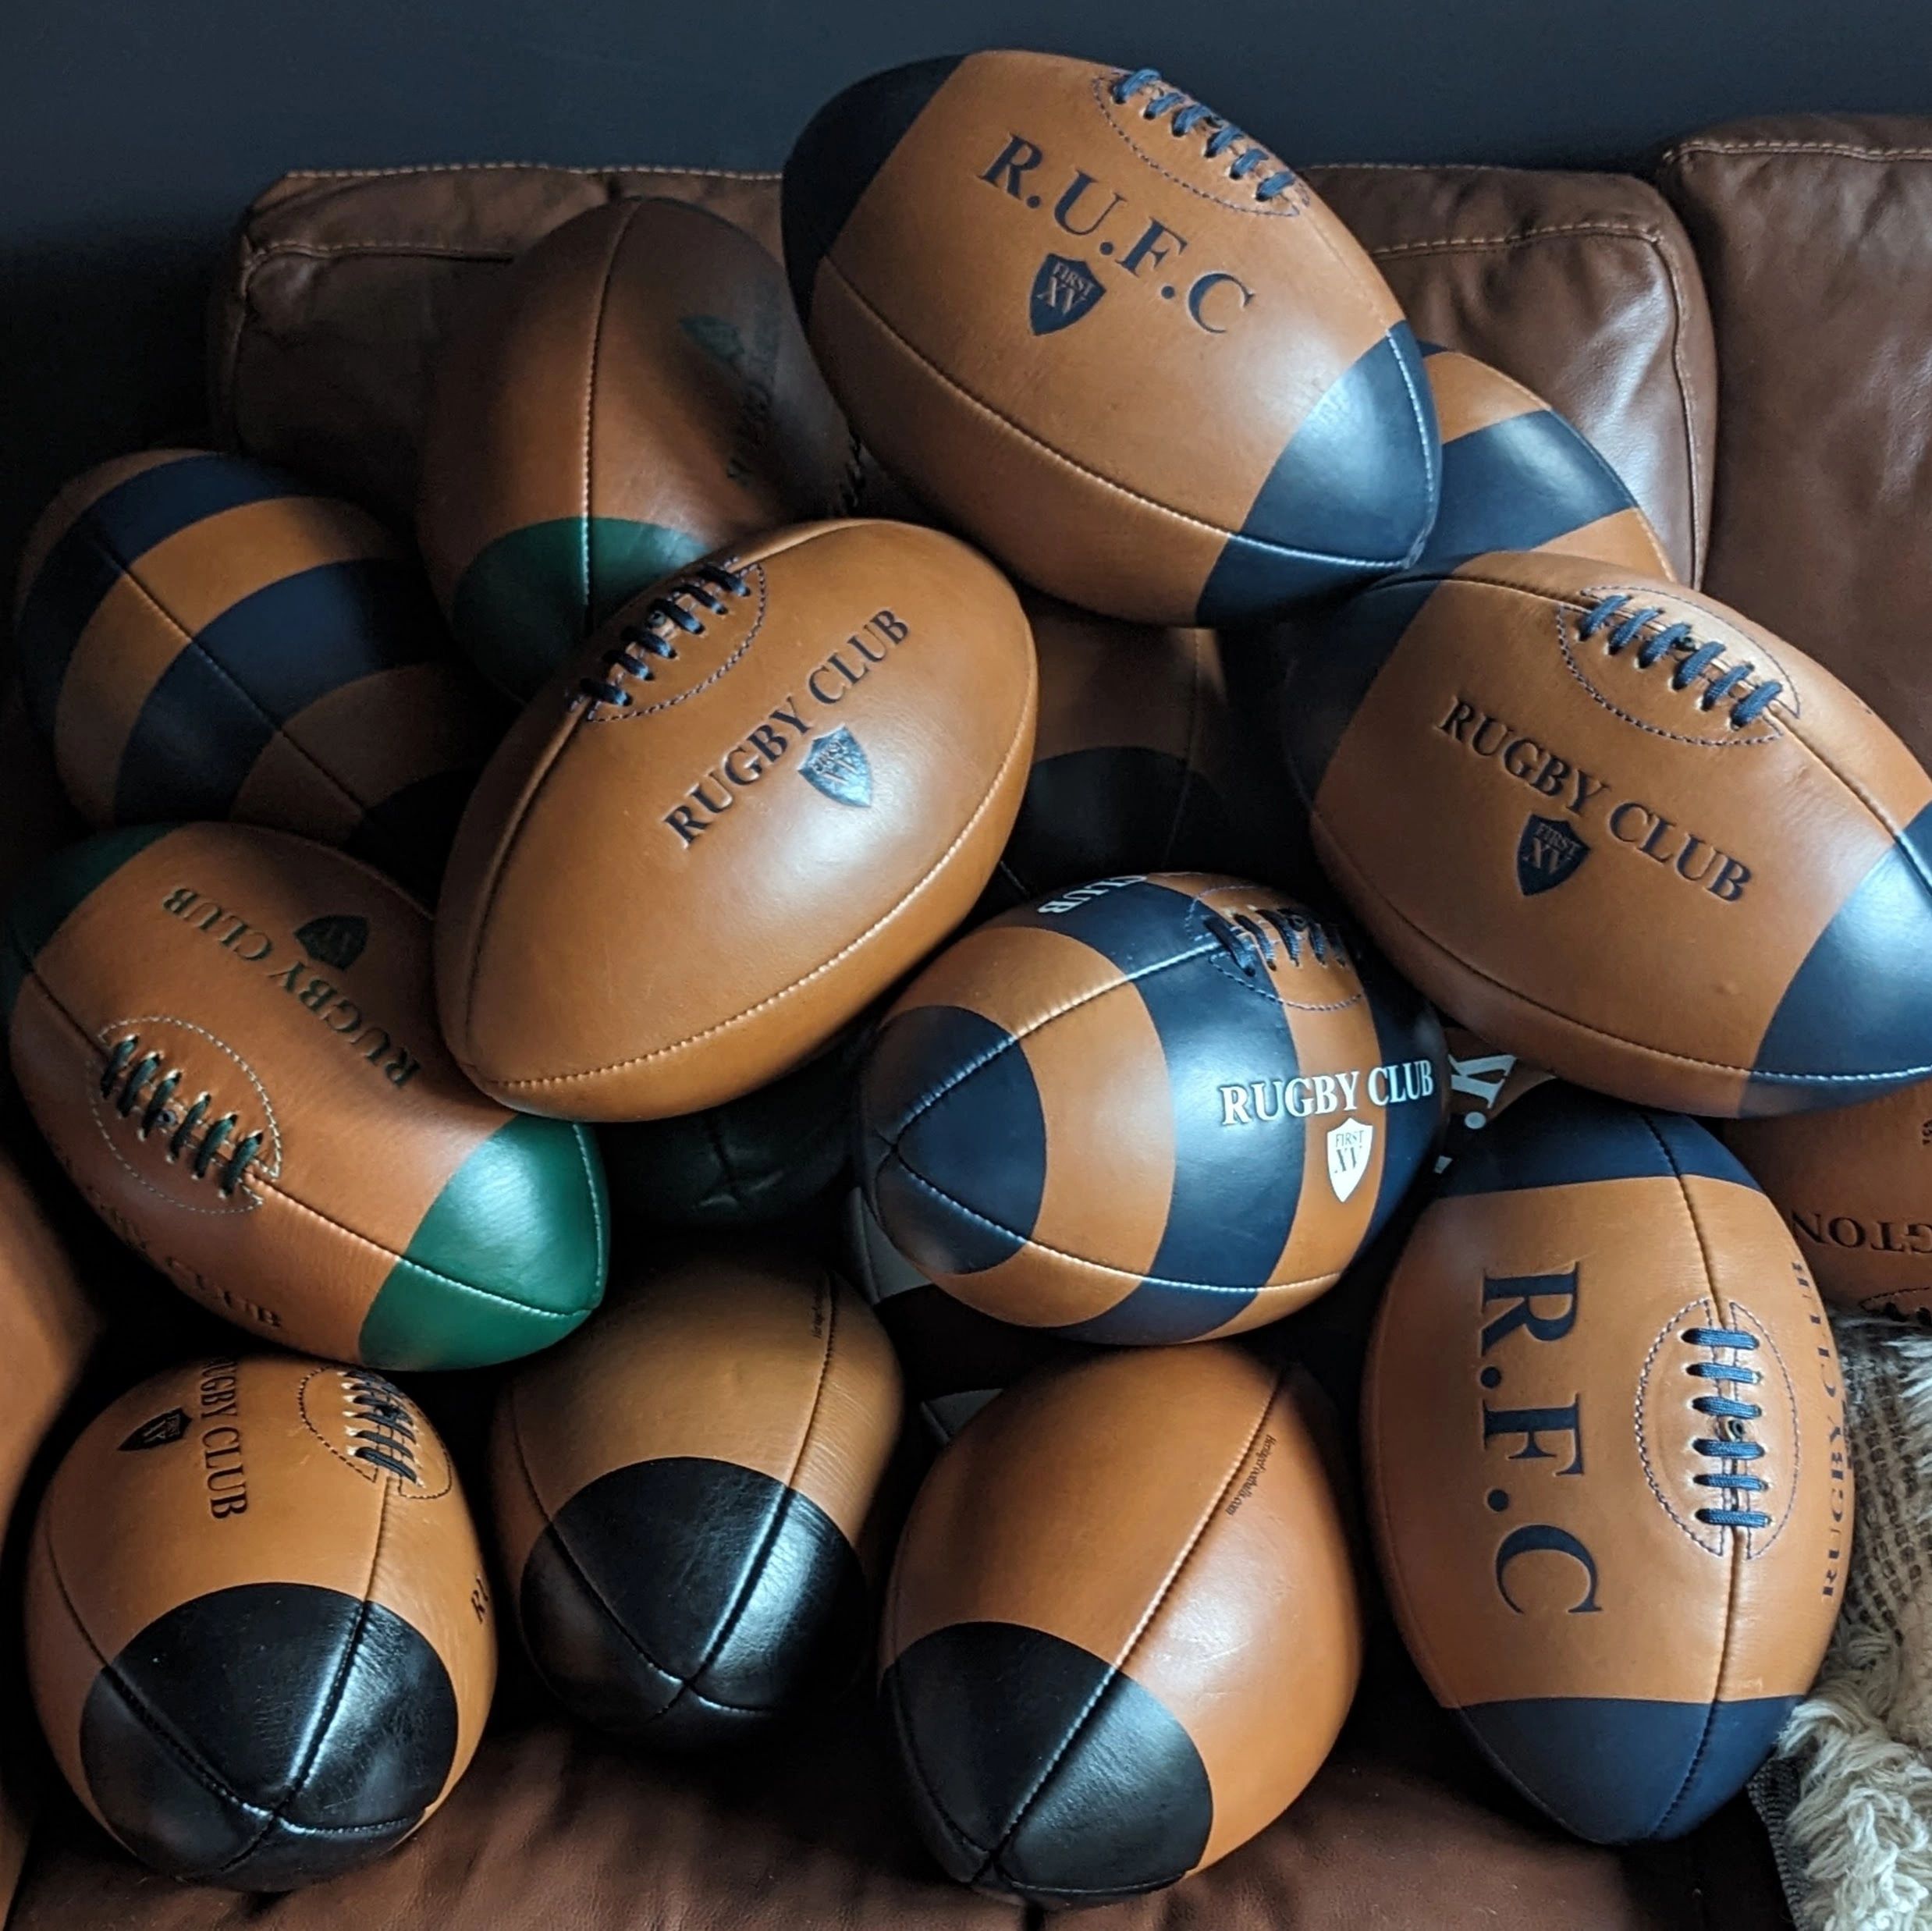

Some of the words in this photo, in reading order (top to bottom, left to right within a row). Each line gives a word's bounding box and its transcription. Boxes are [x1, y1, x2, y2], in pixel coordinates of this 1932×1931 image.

[1037, 275, 1089, 314] XV
[1053, 261, 1094, 296] FIRST
[662, 697, 812, 850] RUGBY
[808, 609, 910, 705] CLUB
[1437, 696, 1611, 817] RUGBY
[1608, 801, 1753, 901] CLUB
[162, 887, 273, 961] CLUB
[268, 961, 421, 1088] RUGBY
[1219, 1071, 1359, 1125] RUGBY
[1369, 1060, 1434, 1106] CLUB
[1335, 1131, 1364, 1148] FIRST
[201, 1427, 249, 1519] CLUB
[1480, 1261, 1603, 1615] R.F.C
[1821, 1415, 1845, 1599] RUGBY
